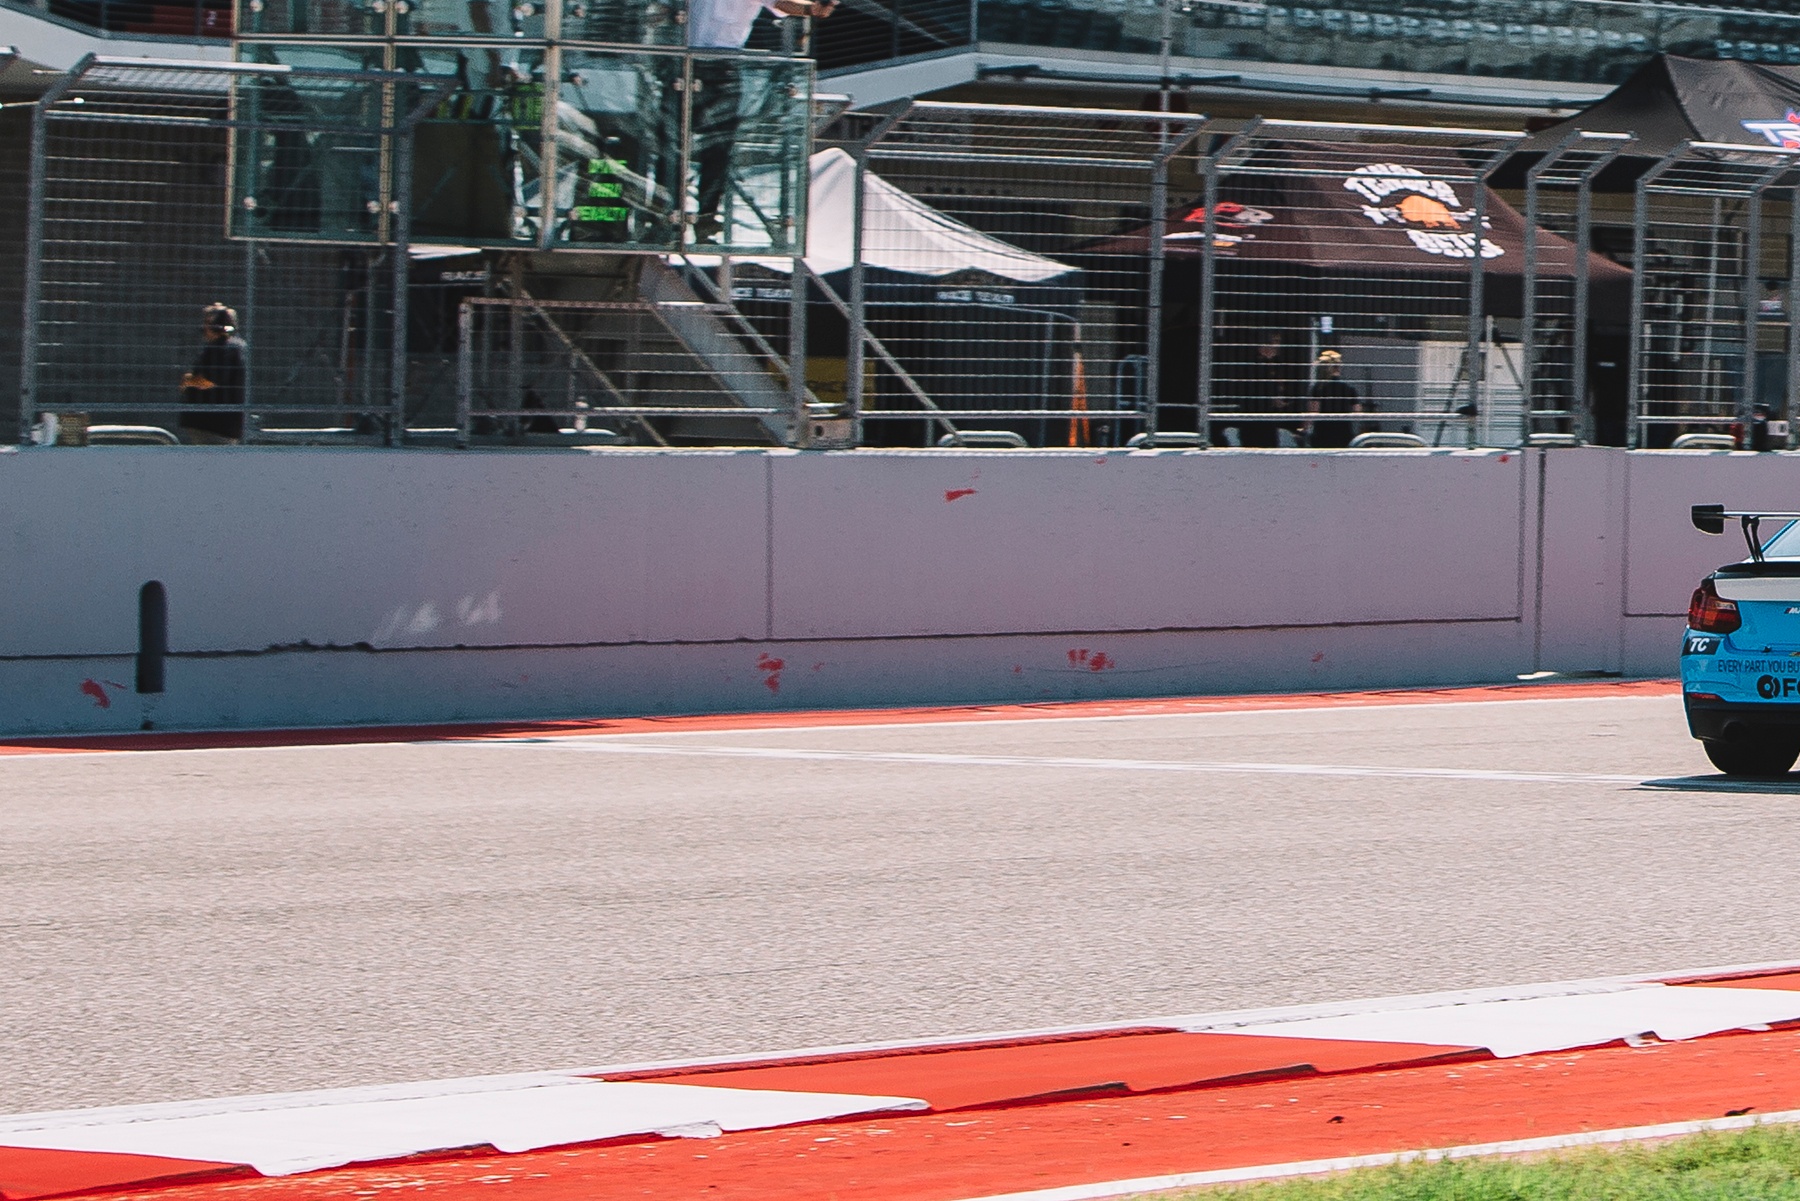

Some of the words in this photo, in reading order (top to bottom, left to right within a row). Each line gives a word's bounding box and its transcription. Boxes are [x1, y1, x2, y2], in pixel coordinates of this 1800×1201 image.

[1689, 637, 1711, 653] TC
[1718, 660, 1742, 673] EVERY
[1745, 660, 1766, 673] PART
[1766, 660, 1786, 673] YOU
